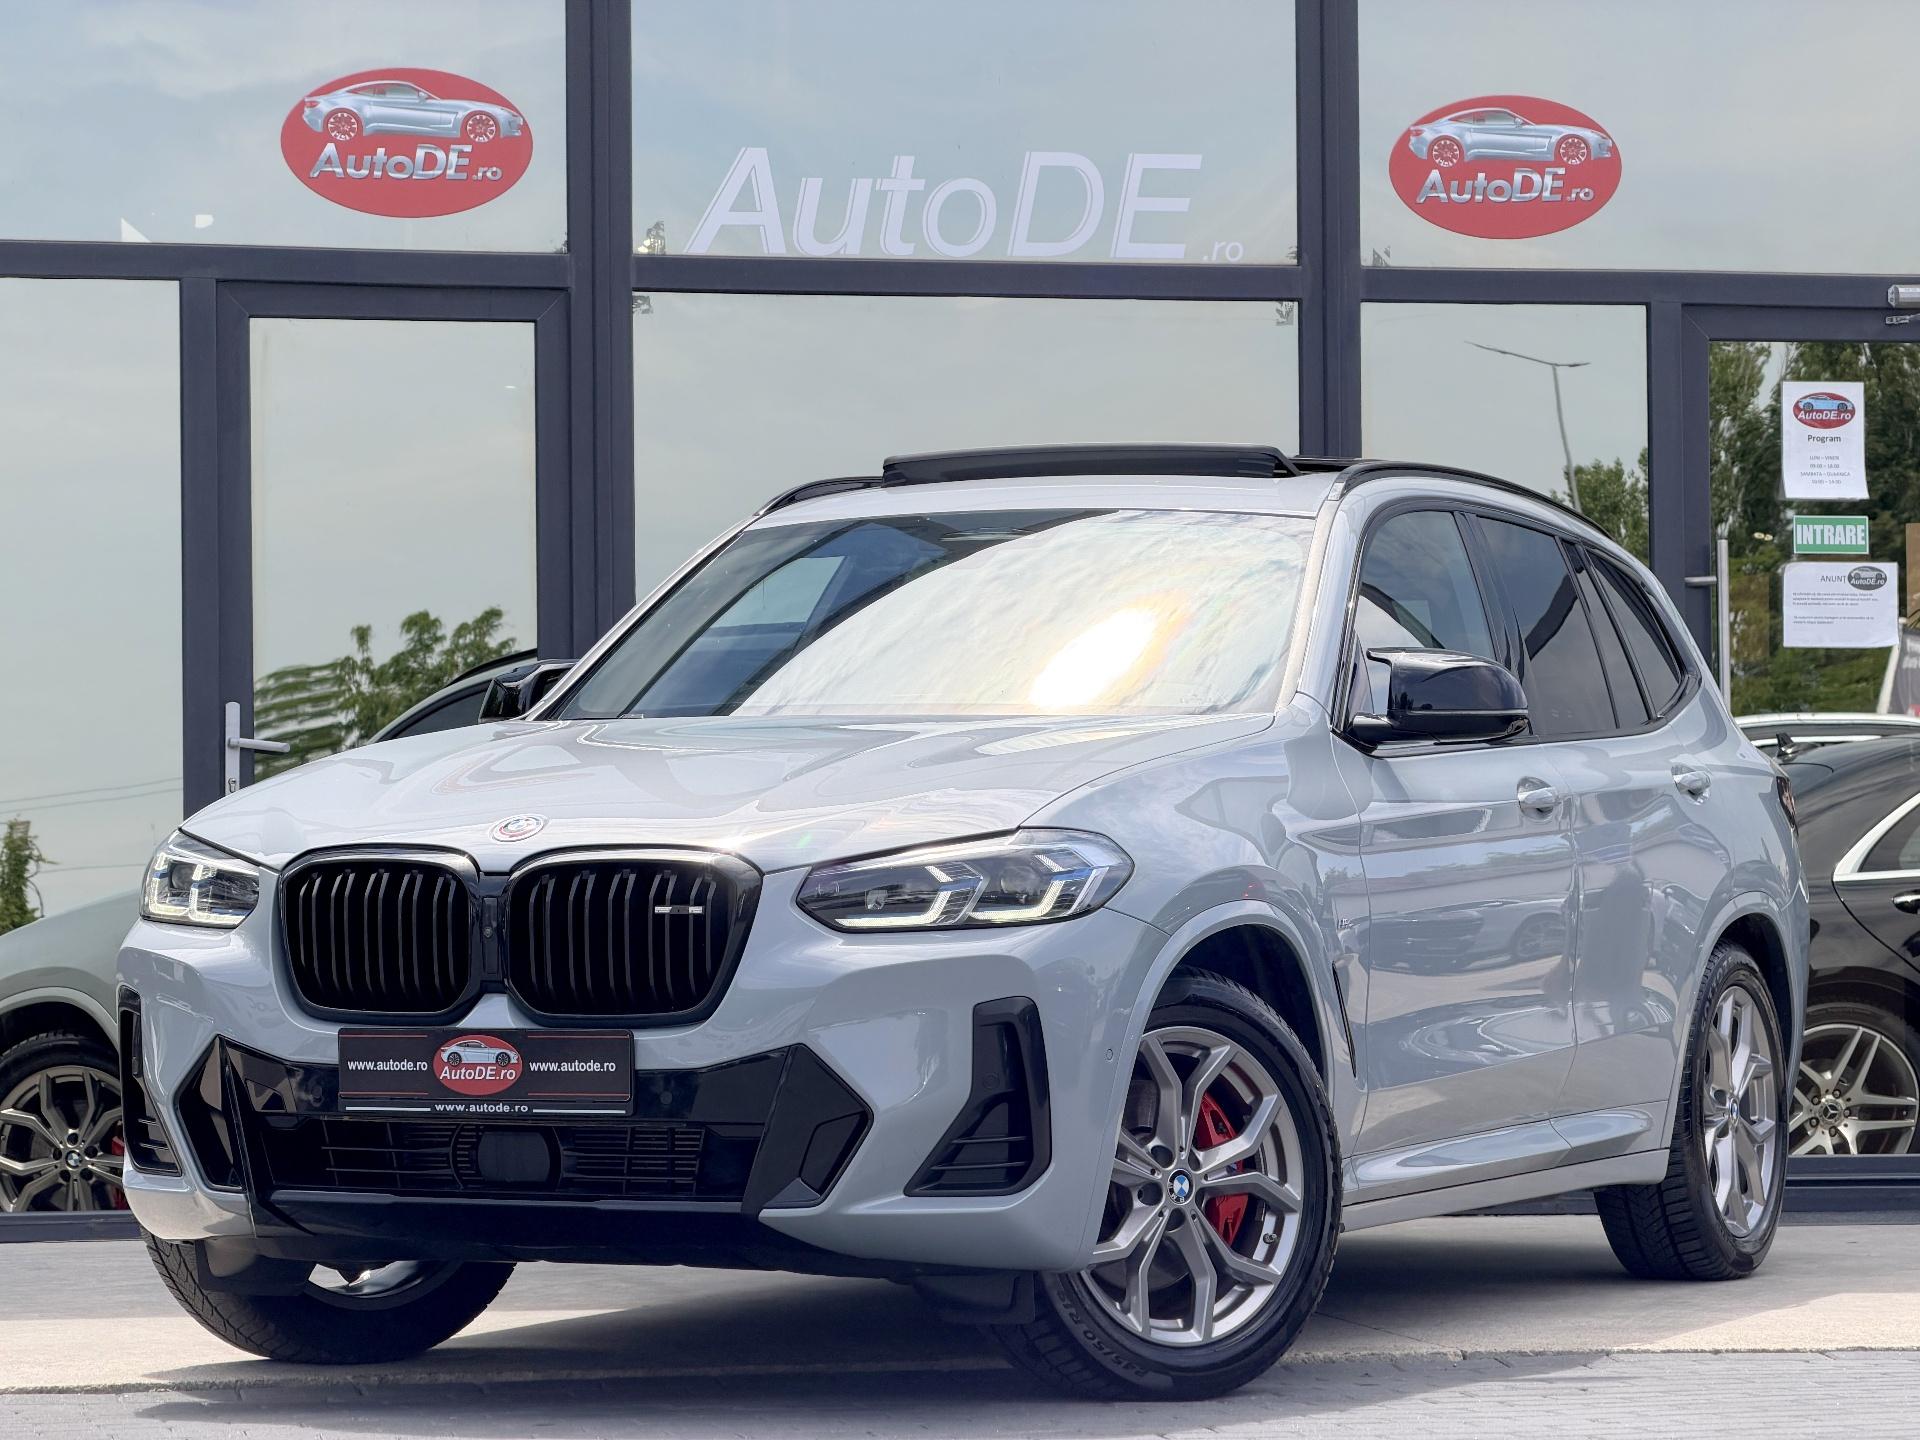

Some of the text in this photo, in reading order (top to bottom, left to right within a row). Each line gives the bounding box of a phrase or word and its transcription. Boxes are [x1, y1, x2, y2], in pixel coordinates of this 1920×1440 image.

[1807, 434, 1842, 444] Program
[1796, 524, 1866, 545] INTRARE
[347, 1059, 428, 1072] www.autode.ro
[529, 1060, 617, 1073] www.autode.ro
[439, 1065, 517, 1081] AutoDE.ro
[434, 1102, 529, 1114] www.autode.ro
